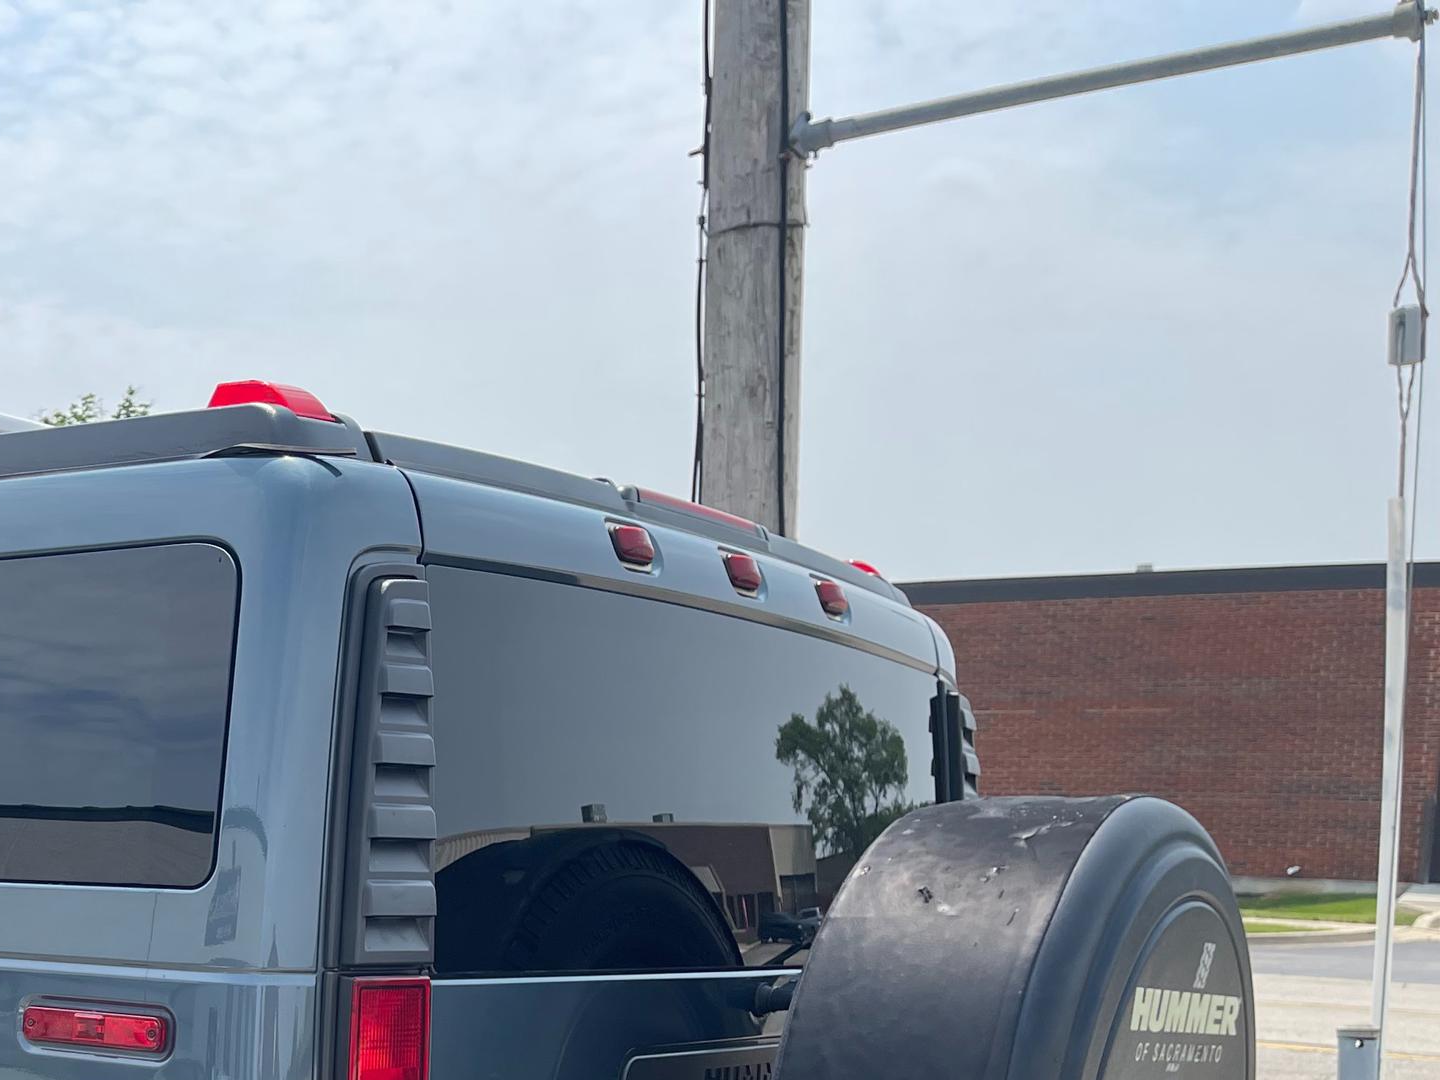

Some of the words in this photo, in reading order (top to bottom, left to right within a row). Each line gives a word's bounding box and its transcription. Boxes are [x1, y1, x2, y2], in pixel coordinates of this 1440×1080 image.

[1130, 986, 1242, 1037] HUMMER
[1135, 1041, 1150, 1062] OF
[1152, 1042, 1223, 1064] SACRAMENTO
